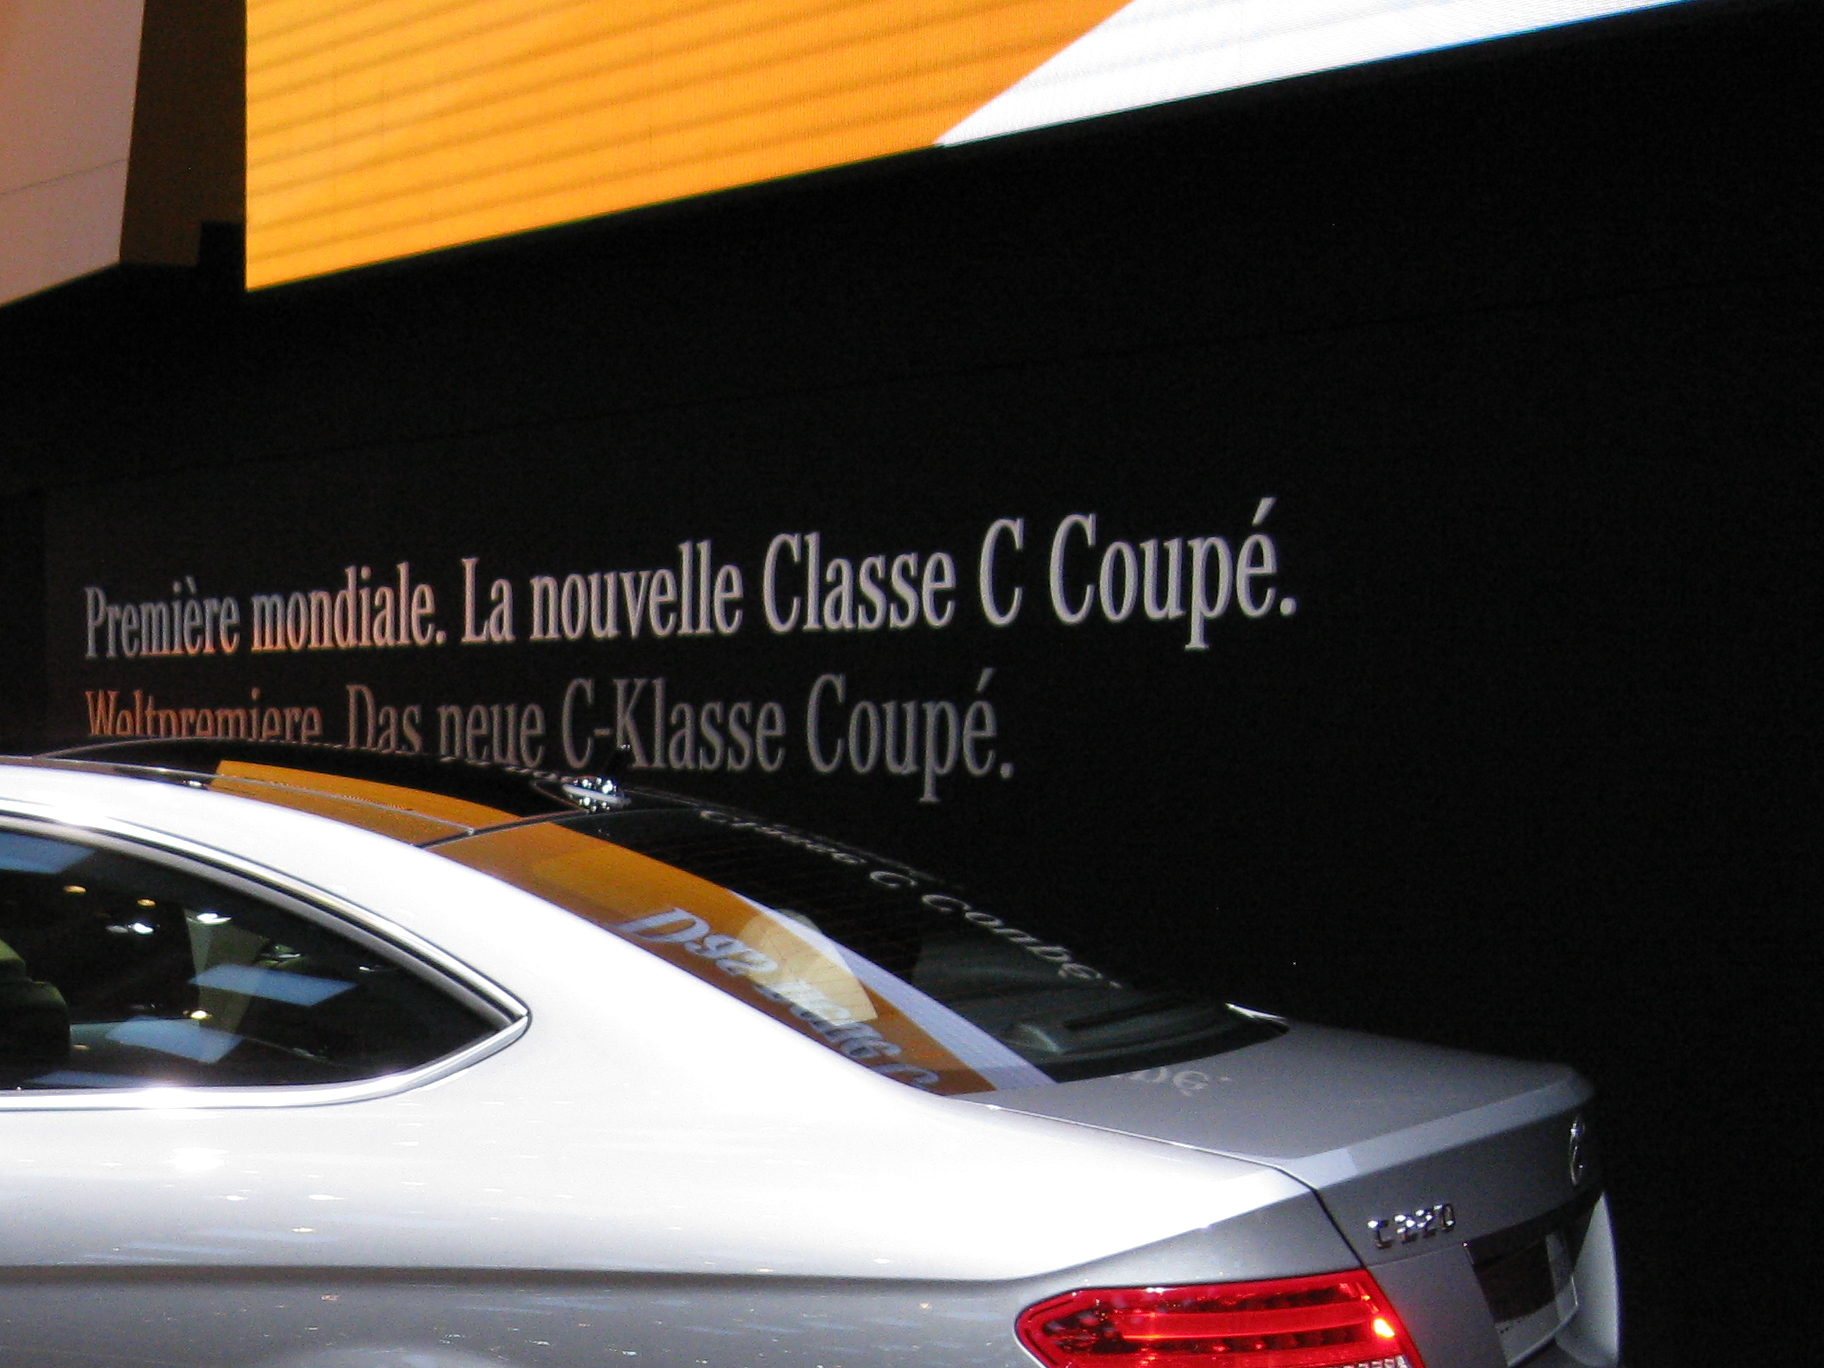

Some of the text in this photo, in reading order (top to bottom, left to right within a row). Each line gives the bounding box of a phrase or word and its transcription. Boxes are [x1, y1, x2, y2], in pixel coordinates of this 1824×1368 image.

[84, 496, 1297, 659] Première mondiale. La nouvelle Classe C Coupé.
[346, 684, 423, 752] Das
[438, 699, 545, 765] neue
[562, 677, 786, 771] C-Klasse
[807, 668, 1014, 803] Coupé.
